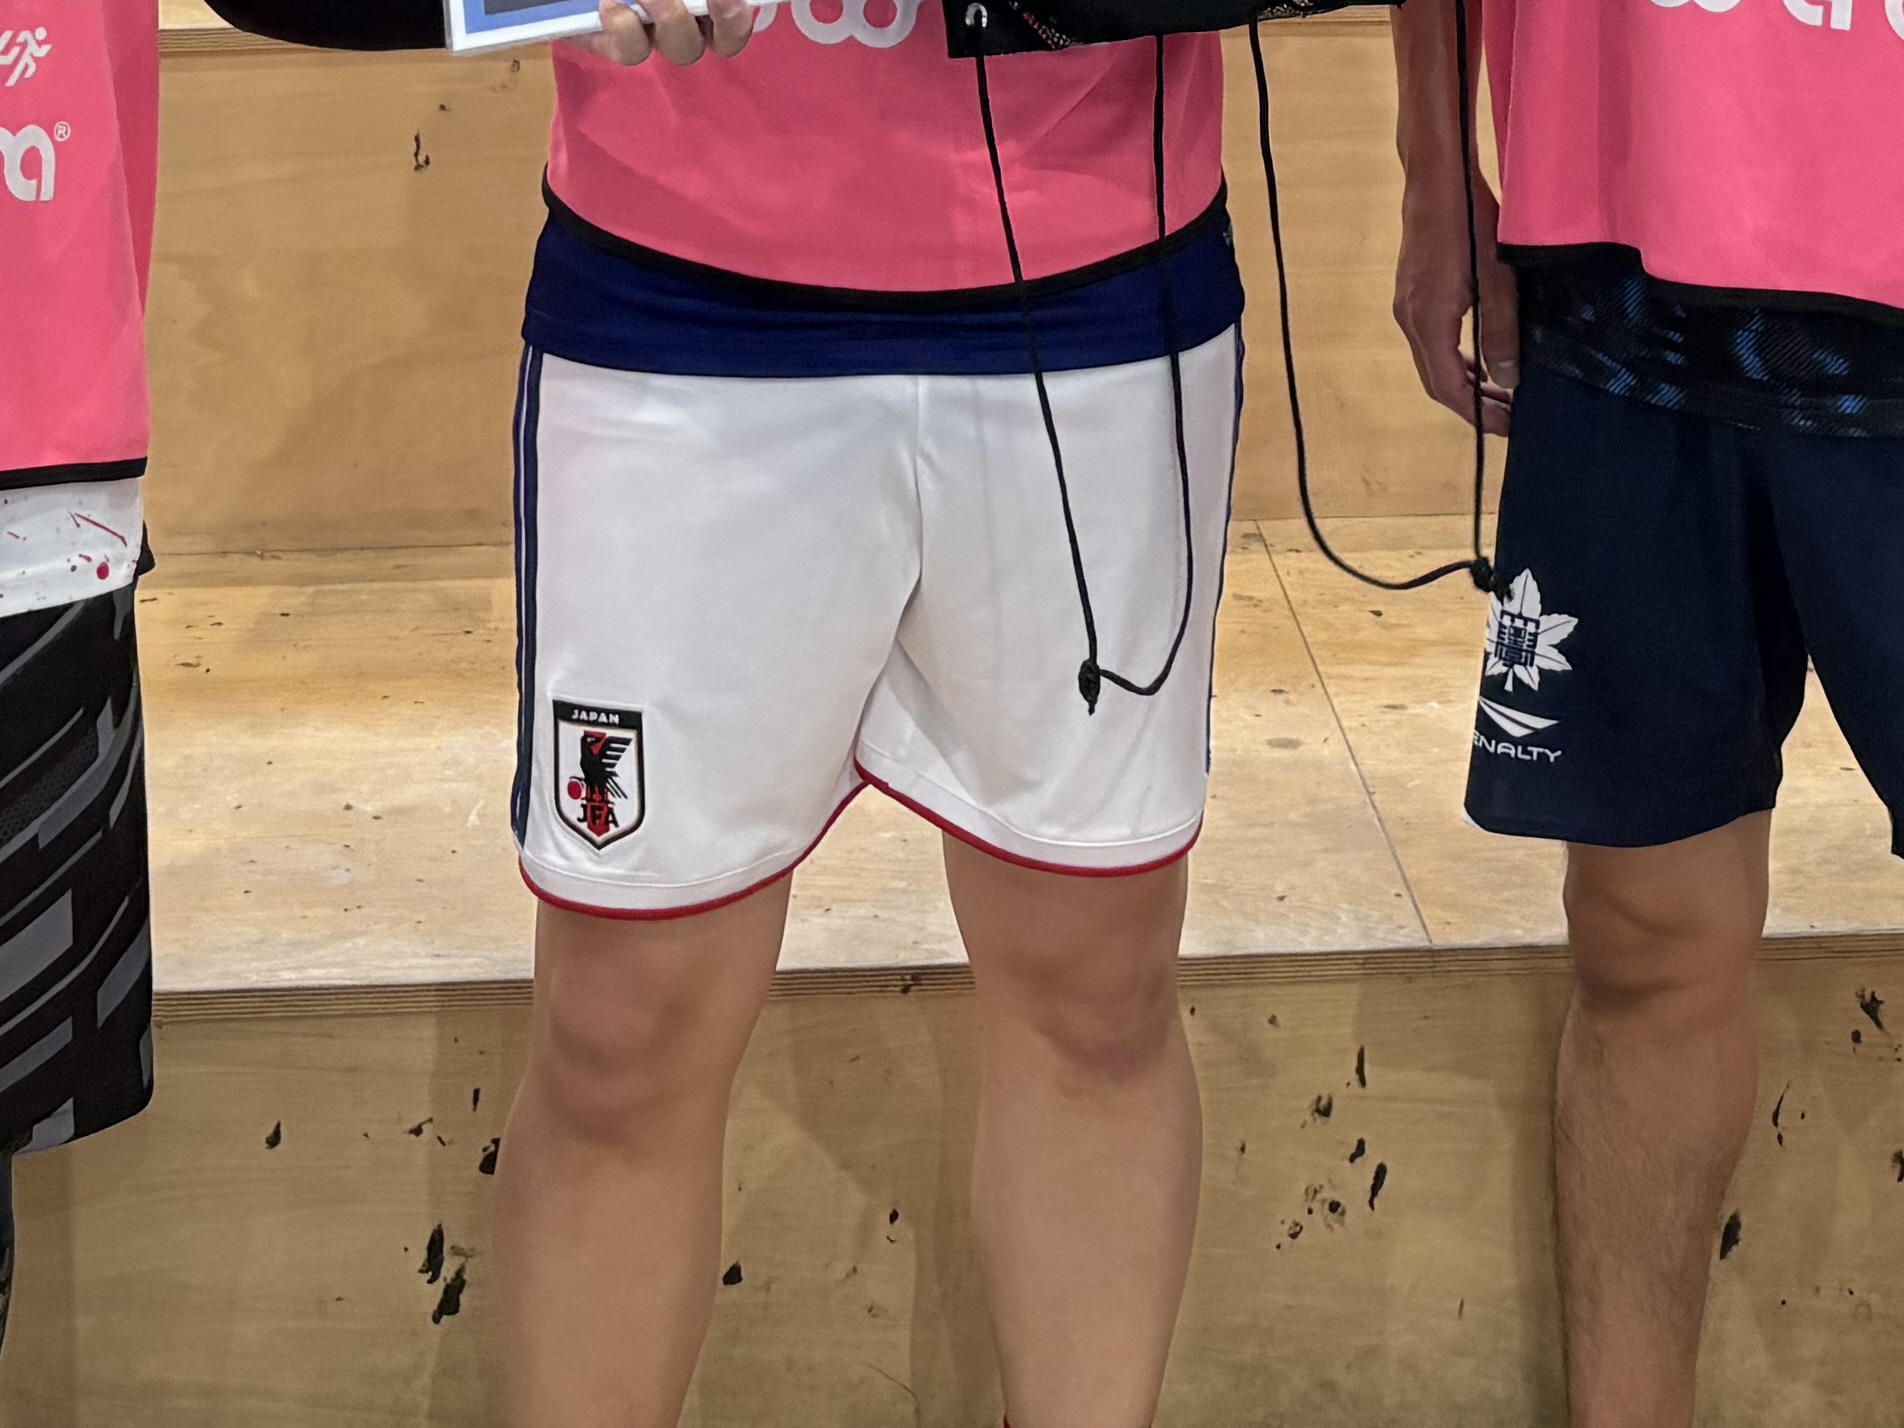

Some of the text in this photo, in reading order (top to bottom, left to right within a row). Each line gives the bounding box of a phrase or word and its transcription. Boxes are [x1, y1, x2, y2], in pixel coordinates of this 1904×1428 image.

[571, 708, 620, 725] JAPAN
[1473, 728, 1563, 763] ENALTY
[576, 803, 620, 829] JFA
